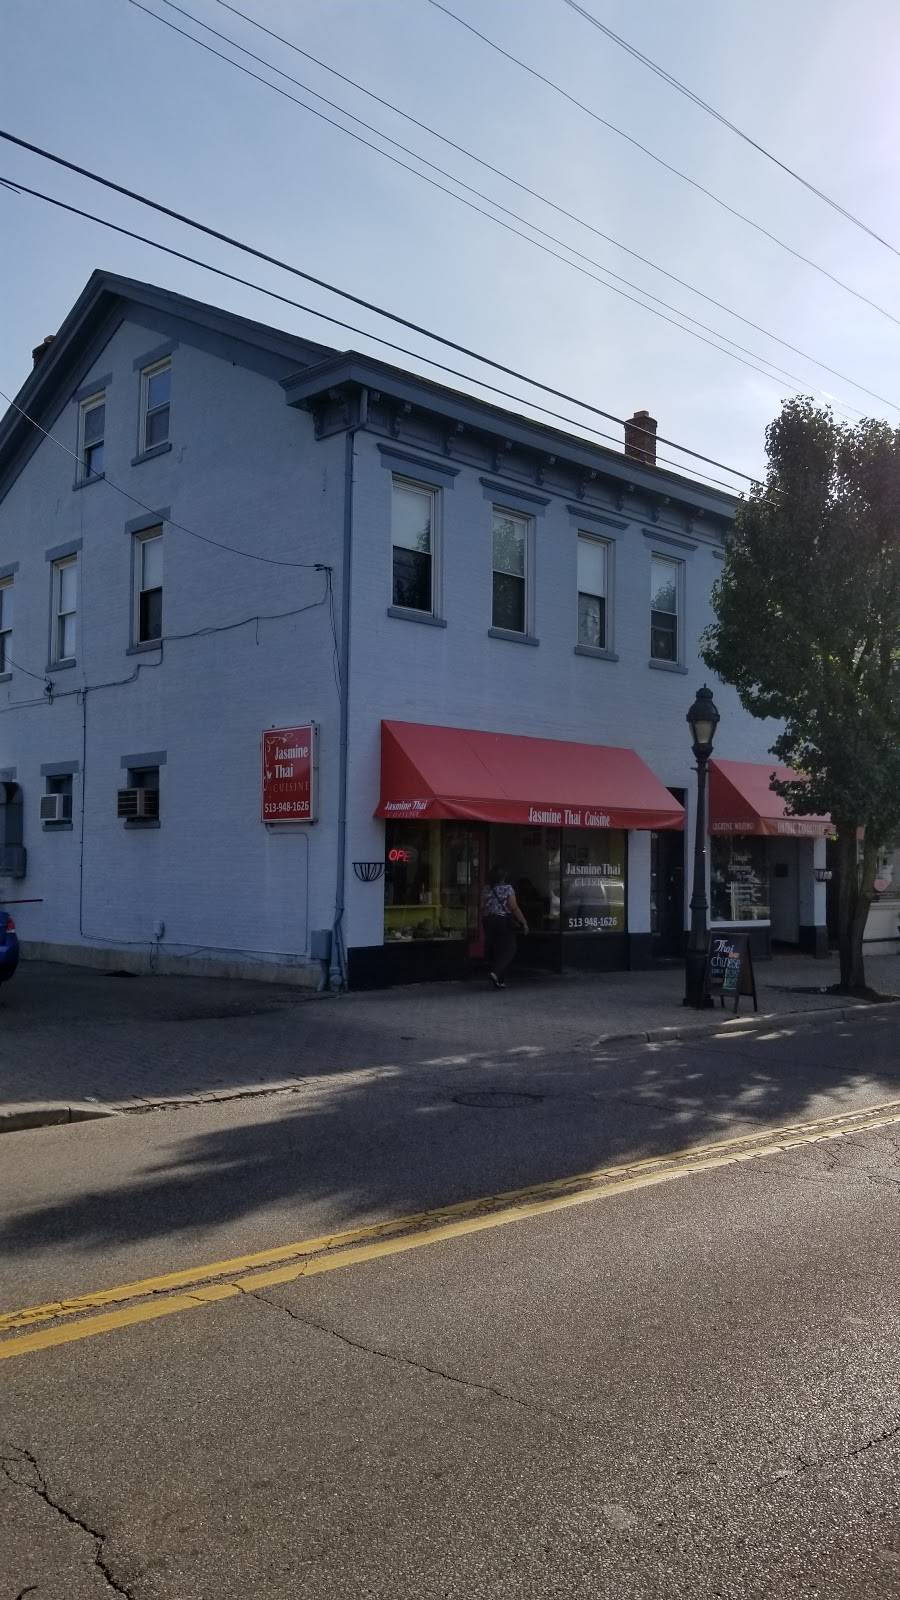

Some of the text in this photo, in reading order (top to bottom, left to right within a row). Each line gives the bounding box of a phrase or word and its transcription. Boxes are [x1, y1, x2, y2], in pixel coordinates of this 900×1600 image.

[275, 745, 309, 760] Jasmine
[275, 764, 294, 778] Thai
[265, 801, 309, 813] 513-948-1626
[385, 800, 428, 811] Jasmine Thai
[528, 807, 610, 828] Jasmine Thai Cuisine
[566, 863, 621, 875] Jasmine Thai
[568, 917, 618, 928] 513 948-1626
